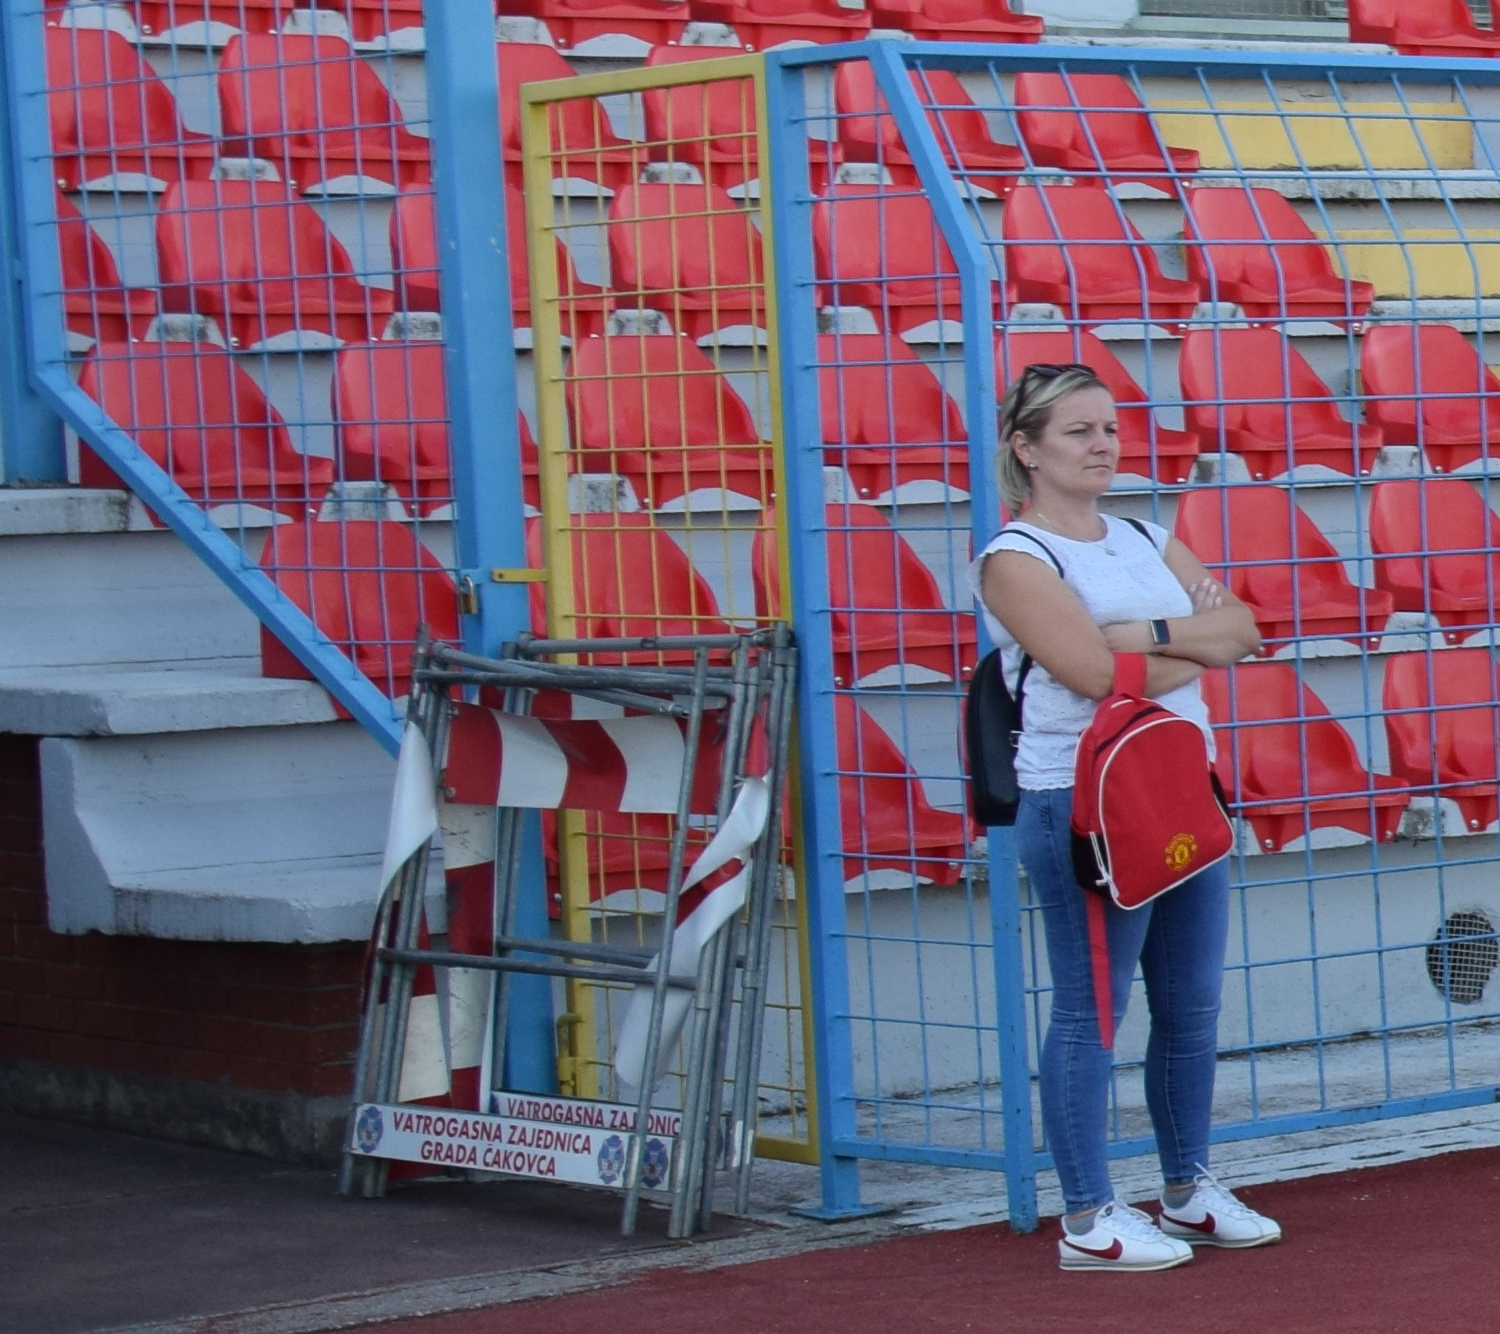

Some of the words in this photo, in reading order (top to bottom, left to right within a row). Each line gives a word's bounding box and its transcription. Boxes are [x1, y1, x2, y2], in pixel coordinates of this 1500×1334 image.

[393, 1112, 502, 1143] VATROGASNA
[508, 1124, 592, 1155] ZAJEDNICA
[507, 1097, 604, 1128] VATROGASNA
[610, 1109, 682, 1136] ZAJDNIC
[420, 1139, 477, 1166] GRADA
[483, 1142, 556, 1177] ČAKOVCA
